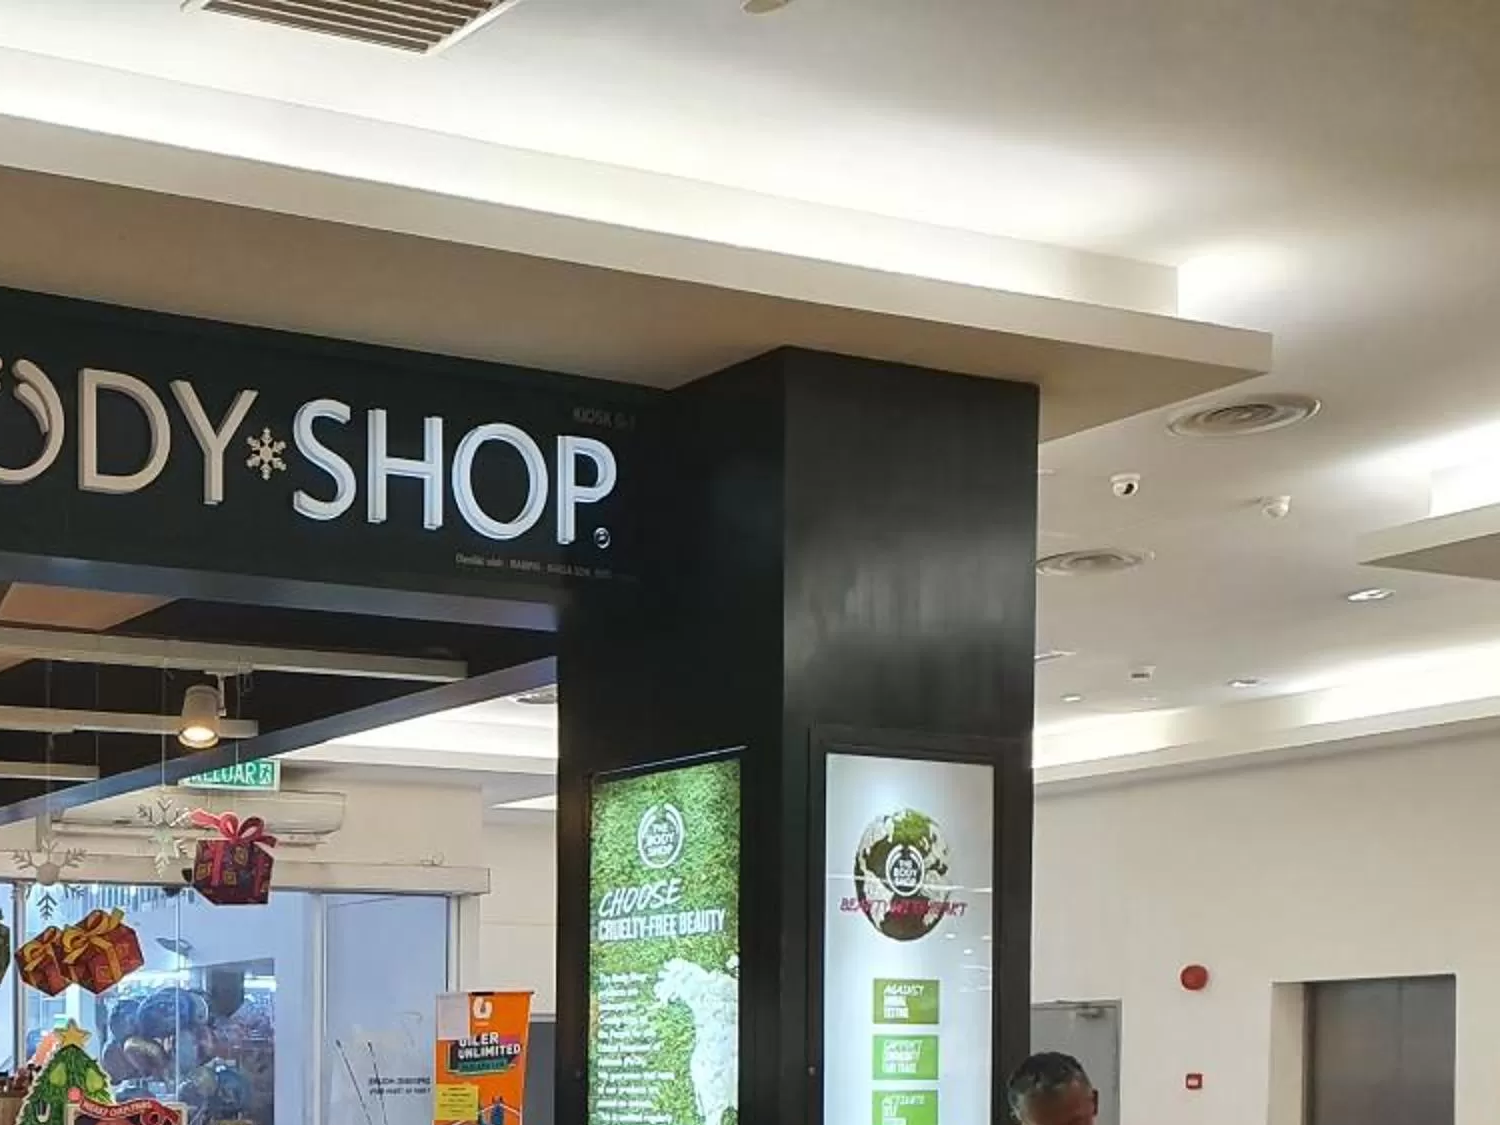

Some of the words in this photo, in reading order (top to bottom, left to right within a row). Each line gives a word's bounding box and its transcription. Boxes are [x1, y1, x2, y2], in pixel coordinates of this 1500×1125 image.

[291, 398, 618, 546] SHOP
[191, 761, 257, 785] LUAR
[598, 878, 683, 918] CHOOSE
[678, 908, 726, 935] BEAUTY
